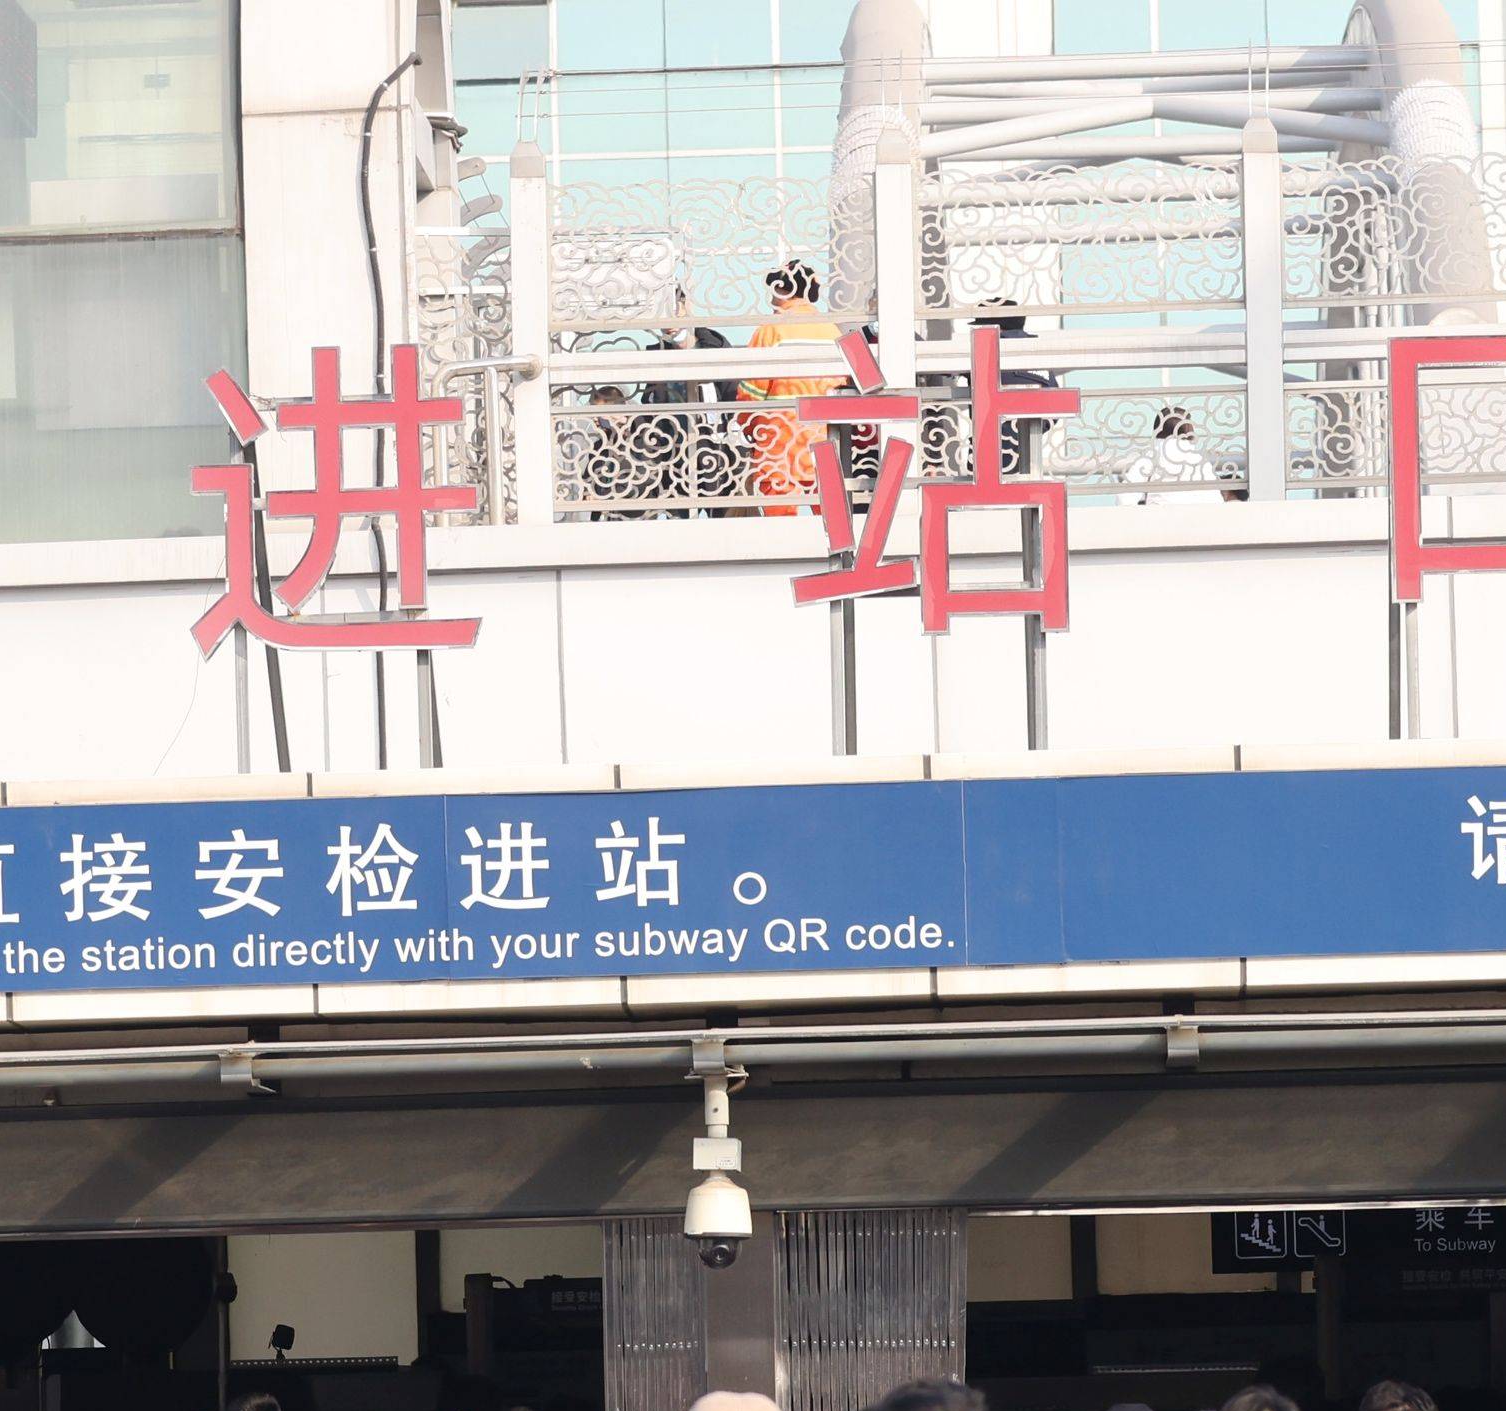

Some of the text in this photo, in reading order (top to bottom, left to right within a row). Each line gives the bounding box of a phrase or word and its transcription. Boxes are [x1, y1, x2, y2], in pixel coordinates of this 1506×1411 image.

[3, 941, 65, 974] the
[82, 937, 215, 971] station
[233, 931, 379, 972] directly
[394, 928, 473, 962] with
[491, 933, 580, 968] your
[595, 923, 748, 962] subway
[764, 918, 829, 953] QR
[846, 916, 954, 950] code.
[1413, 1235, 1497, 1254] To Subway
